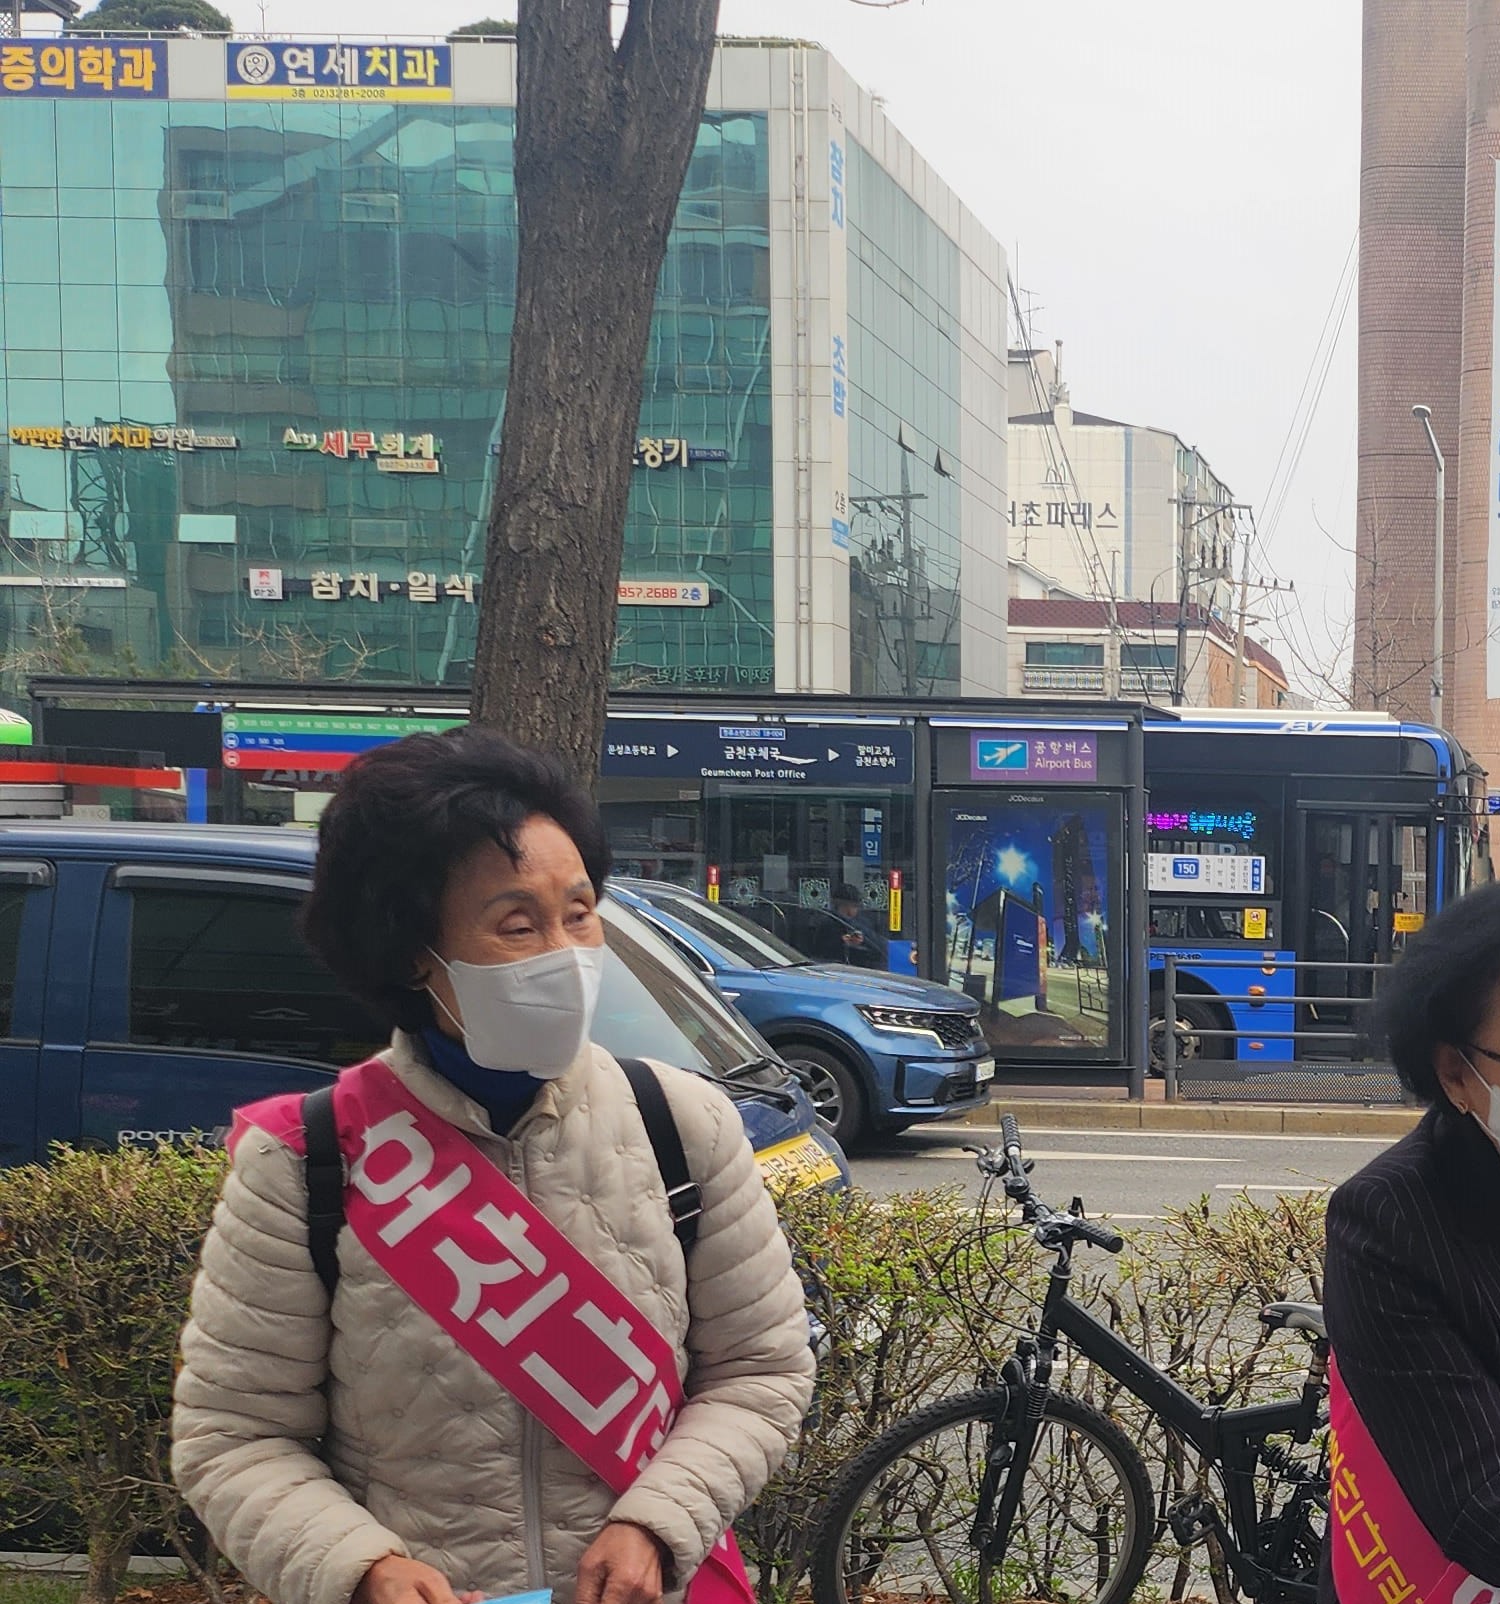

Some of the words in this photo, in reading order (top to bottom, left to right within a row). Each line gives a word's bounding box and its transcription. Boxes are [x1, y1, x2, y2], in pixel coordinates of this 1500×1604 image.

[282, 47, 441, 86] 연세치과
[320, 429, 435, 460] 세무회계
[723, 746, 781, 760] 금천우체국
[1034, 758, 1071, 770] Airport
[1073, 758, 1092, 769] Bus
[701, 767, 752, 778] Geumcheon
[755, 768, 775, 778] Post
[777, 768, 807, 779] Office
[1177, 863, 1196, 875] 150
